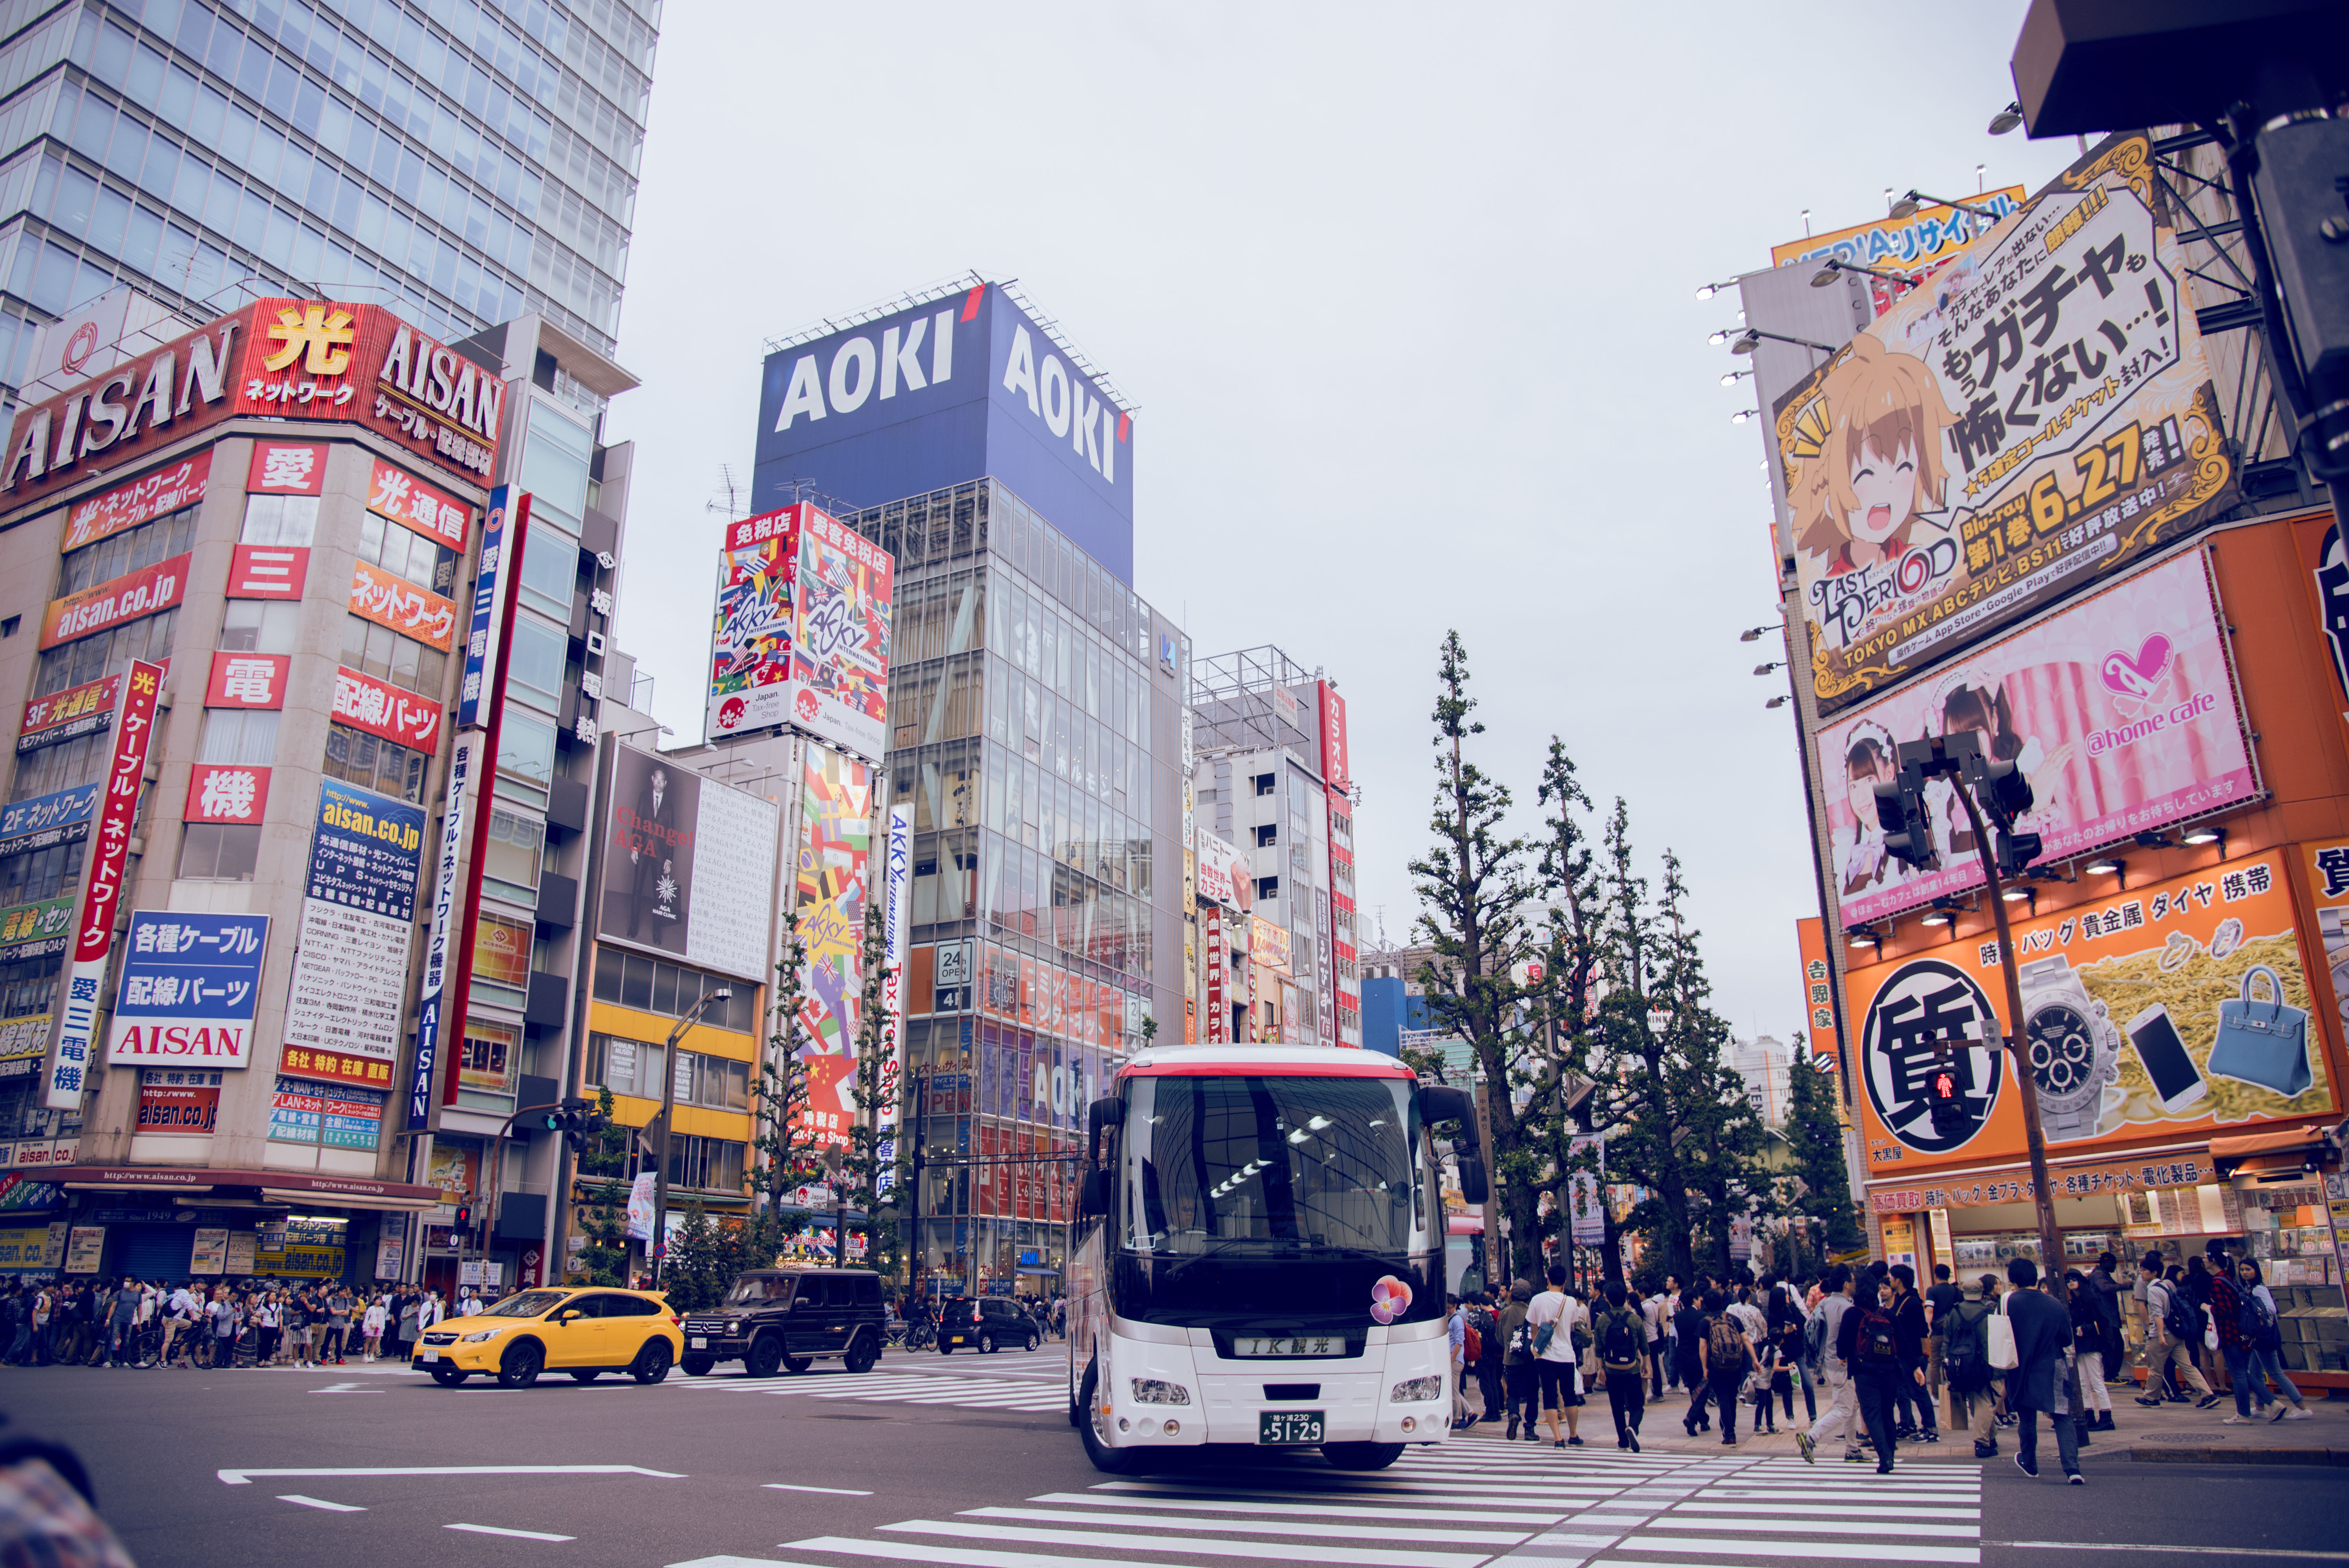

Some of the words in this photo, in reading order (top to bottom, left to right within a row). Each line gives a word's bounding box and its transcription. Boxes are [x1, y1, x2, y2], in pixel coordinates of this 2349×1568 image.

[262, 305, 355, 376] 光
[380, 323, 504, 441] AISAN
[774, 308, 954, 433] AOKI
[1, 319, 242, 493] AISAN
[245, 379, 355, 406] ネットワーク
[1003, 323, 1114, 485] AOKI
[375, 394, 493, 477] ケーブル・配線部材
[262, 447, 314, 490] 愛
[2031, 424, 2140, 533] 6.27
[370, 470, 465, 542] 光通信
[1962, 495, 2026, 541] Blu-ray
[735, 511, 791, 546] 免税店
[813, 512, 887, 576] 愛客免税店
[1966, 515, 2031, 572] 第1巻
[242, 551, 294, 591] 三
[57, 574, 177, 639] aisan.co.jp
[351, 570, 454, 639] ネットワーク
[1808, 562, 1874, 626] LAST
[1842, 537, 1958, 649] PERIOD
[462, 545, 499, 703] 愛三電機
[723, 592, 776, 649] AKKY
[748, 620, 788, 635] INTERNATIONAL
[807, 597, 866, 656] AKKY
[837, 642, 879, 670] INTERNATIONAL
[1843, 630, 1898, 668] TOKYO
[1897, 634, 1932, 658] 原作ゲーム
[1934, 624, 1953, 642] App
[225, 658, 275, 703] 電
[576, 588, 612, 746] 坂口電熱
[332, 674, 437, 739] 配線パーツ
[752, 700, 780, 713] Tax-free
[755, 690, 780, 702] Japan.
[25, 702, 49, 727] 3F
[761, 709, 779, 720] Shop
[822, 711, 843, 727] Japan.
[844, 721, 866, 739] Tax-free
[866, 731, 882, 746] Shop
[2086, 710, 2166, 758] @home
[2169, 690, 2215, 726] cafe
[1330, 697, 1342, 780] カラオケ
[1183, 766, 1192, 777] 8F
[83, 671, 156, 947] 光・ケーブル・ネットワーク
[200, 770, 255, 817] 機
[326, 789, 370, 809] http://www.
[1, 807, 26, 834] 2F
[26, 787, 98, 830] ネットワーク
[616, 805, 694, 848] Change!
[323, 802, 420, 852] aisan.co.jp
[614, 828, 657, 858] AGA
[891, 813, 907, 883] AKKY
[1206, 835, 1231, 857] ハニトー
[428, 746, 469, 986] 各種ケーブル・ネットワーク機器
[1201, 862, 1232, 886] 曲数世界一
[1201, 878, 1232, 900] カラオケ
[659, 905, 671, 913] AGA
[663, 911, 677, 920] CLINIC
[887, 866, 898, 961] INTERNATIONAL
[2020, 919, 2076, 954] バッグ
[2082, 904, 2143, 939] 貴金属
[2151, 880, 2214, 921] ダイヤ
[2222, 862, 2272, 902] 携帯
[136, 923, 259, 954] 各種ケーブル
[825, 937, 855, 950] INTERNATIONAL
[1280, 934, 1289, 946] DVD
[942, 966, 966, 978] OPEN
[125, 976, 251, 1007] 配線パーツ
[943, 992, 963, 1007] 4F
[1807, 959, 1833, 1030] 吉野家
[54, 977, 98, 1092] 愛三電機
[116, 1026, 243, 1056] AISAN
[613, 1041, 635, 1051] SHIMURA
[961, 1020, 971, 1053] AOKI
[287, 1049, 310, 1069] 各社
[314, 1054, 337, 1073] 特約
[341, 1058, 364, 1077] 在庫
[367, 1062, 390, 1081] 直販
[413, 1003, 437, 1117] AISAN
[615, 1048, 633, 1056] MUSEN
[920, 1058, 971, 1074] 大きいサイズ
[143, 1089, 196, 1098] http://www.
[146, 1072, 163, 1084] 各社
[167, 1073, 184, 1085] 特約
[188, 1073, 205, 1085] 在庫
[804, 1111, 839, 1130] 免税店
[1479, 1098, 1488, 1131] 中央通り
[276, 1126, 317, 1142] 配線材料
[827, 1131, 849, 1147] Shop
[957, 1121, 969, 1153] AOKI
[1873, 1146, 1903, 1163] 大黒屋
[103, 1172, 196, 1183] http://www.aisan.co.jp
[312, 1180, 384, 1194] http://www.aisan.co.jp
[1872, 1192, 1921, 1211] 高価買取
[2273, 1192, 2319, 1206] 高額買取
[146, 1211, 171, 1221] 1949
[792, 1234, 818, 1245] Tax-free
[818, 1235, 834, 1245] Shop
[845, 1239, 860, 1247] 免税店
[956, 1224, 967, 1256] AOKI
[285, 1247, 343, 1276] aisan.co.jp
[1021, 1251, 1039, 1265] AOKI
[1271, 1422, 1321, 1441] 51-29
